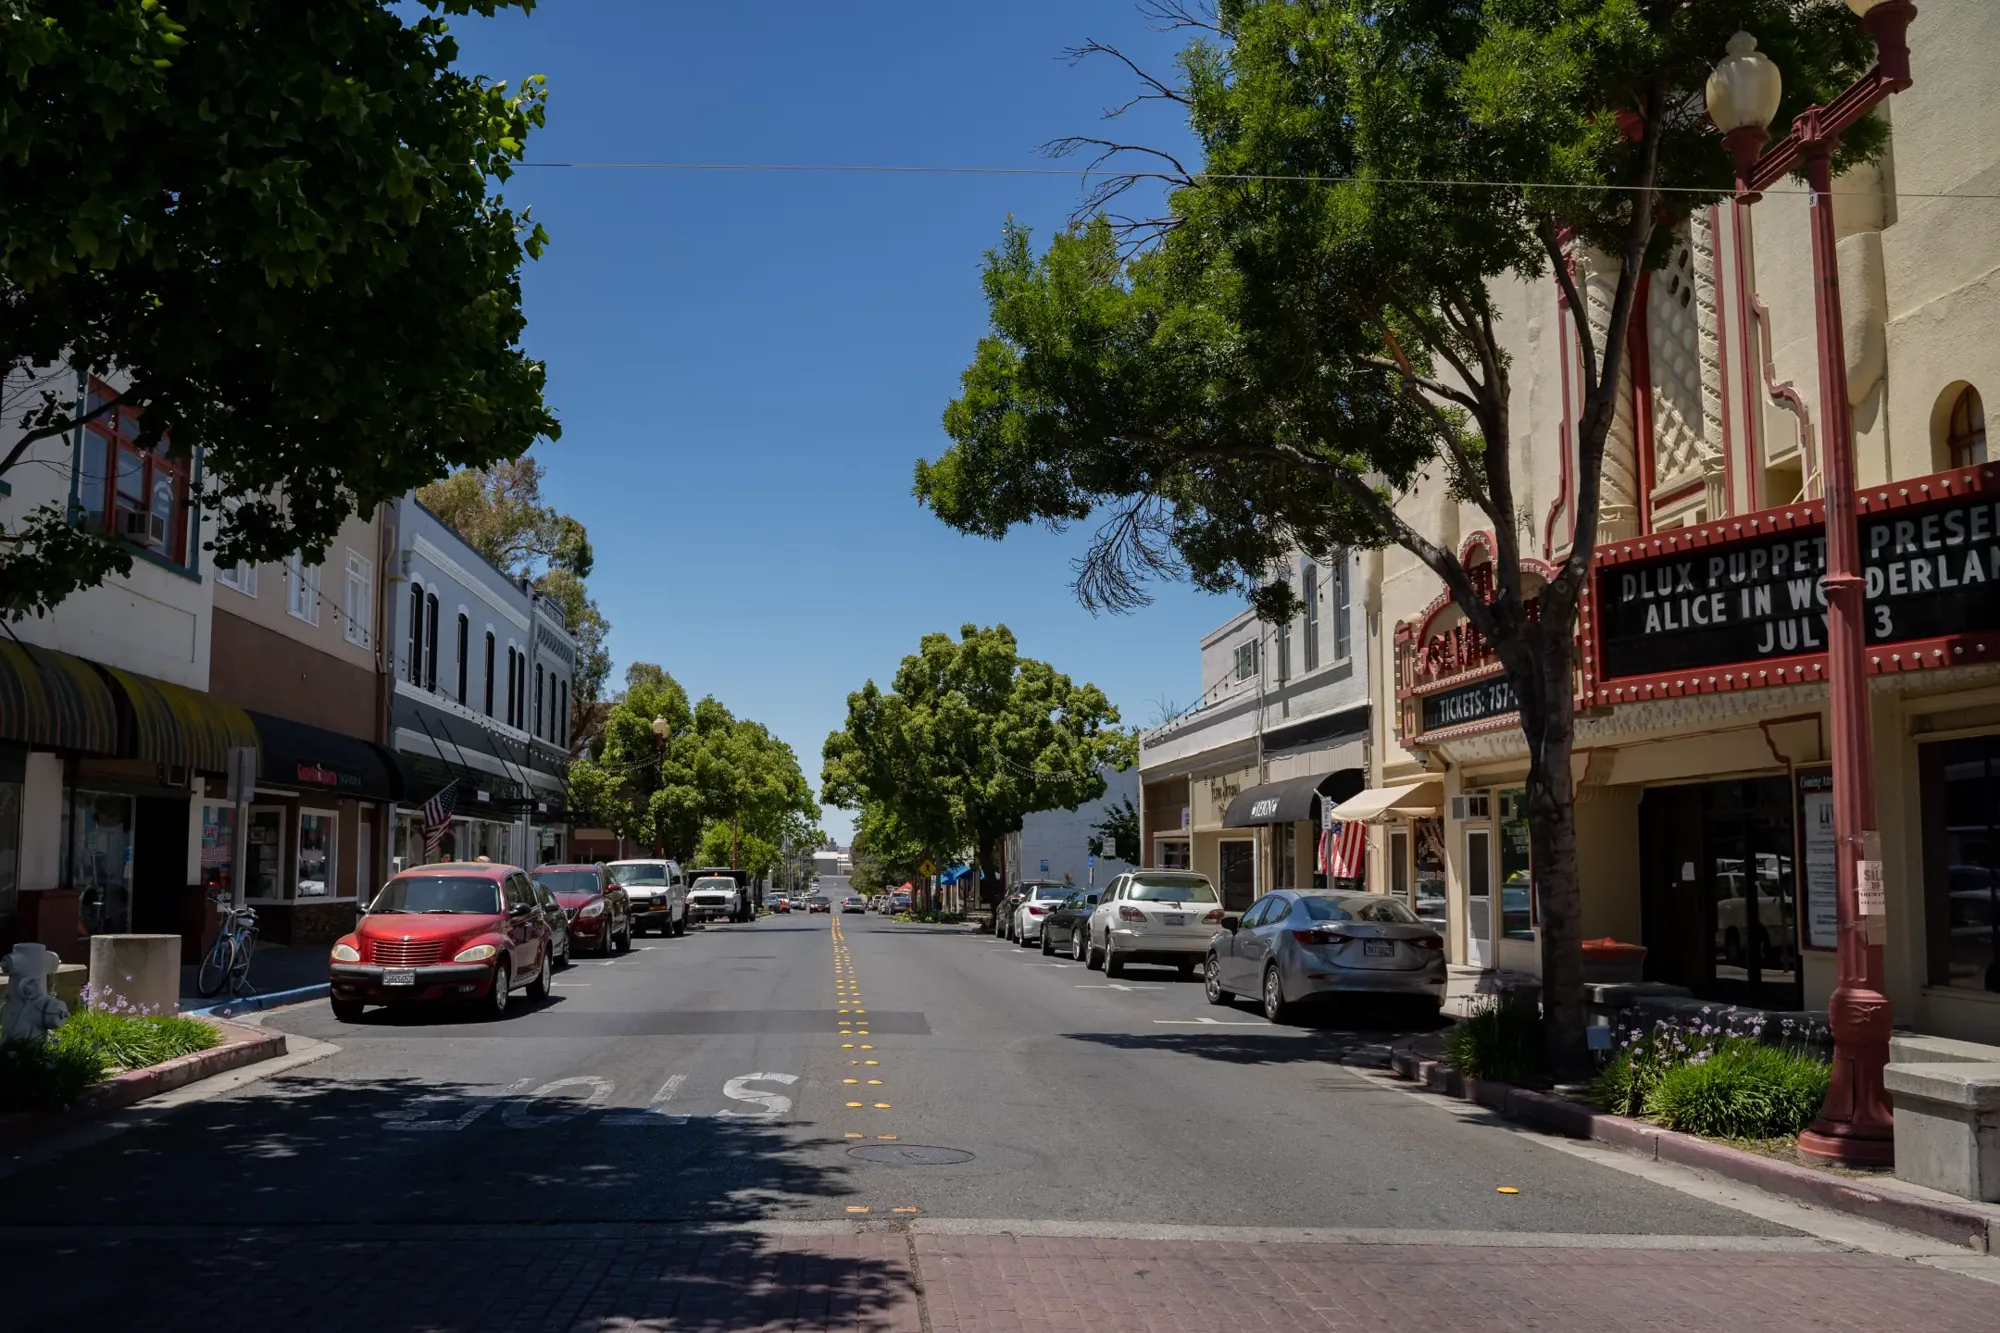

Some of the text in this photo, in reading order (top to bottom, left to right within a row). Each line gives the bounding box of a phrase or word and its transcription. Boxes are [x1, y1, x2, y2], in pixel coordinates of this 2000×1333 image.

[1621, 562, 1694, 602] DLUX
[1870, 502, 2000, 559] PRESE
[1645, 546, 2000, 634] ALICE IN WODERLA
[1874, 603, 1894, 638] 3
[1440, 682, 1519, 722] TICKETS: 757-
